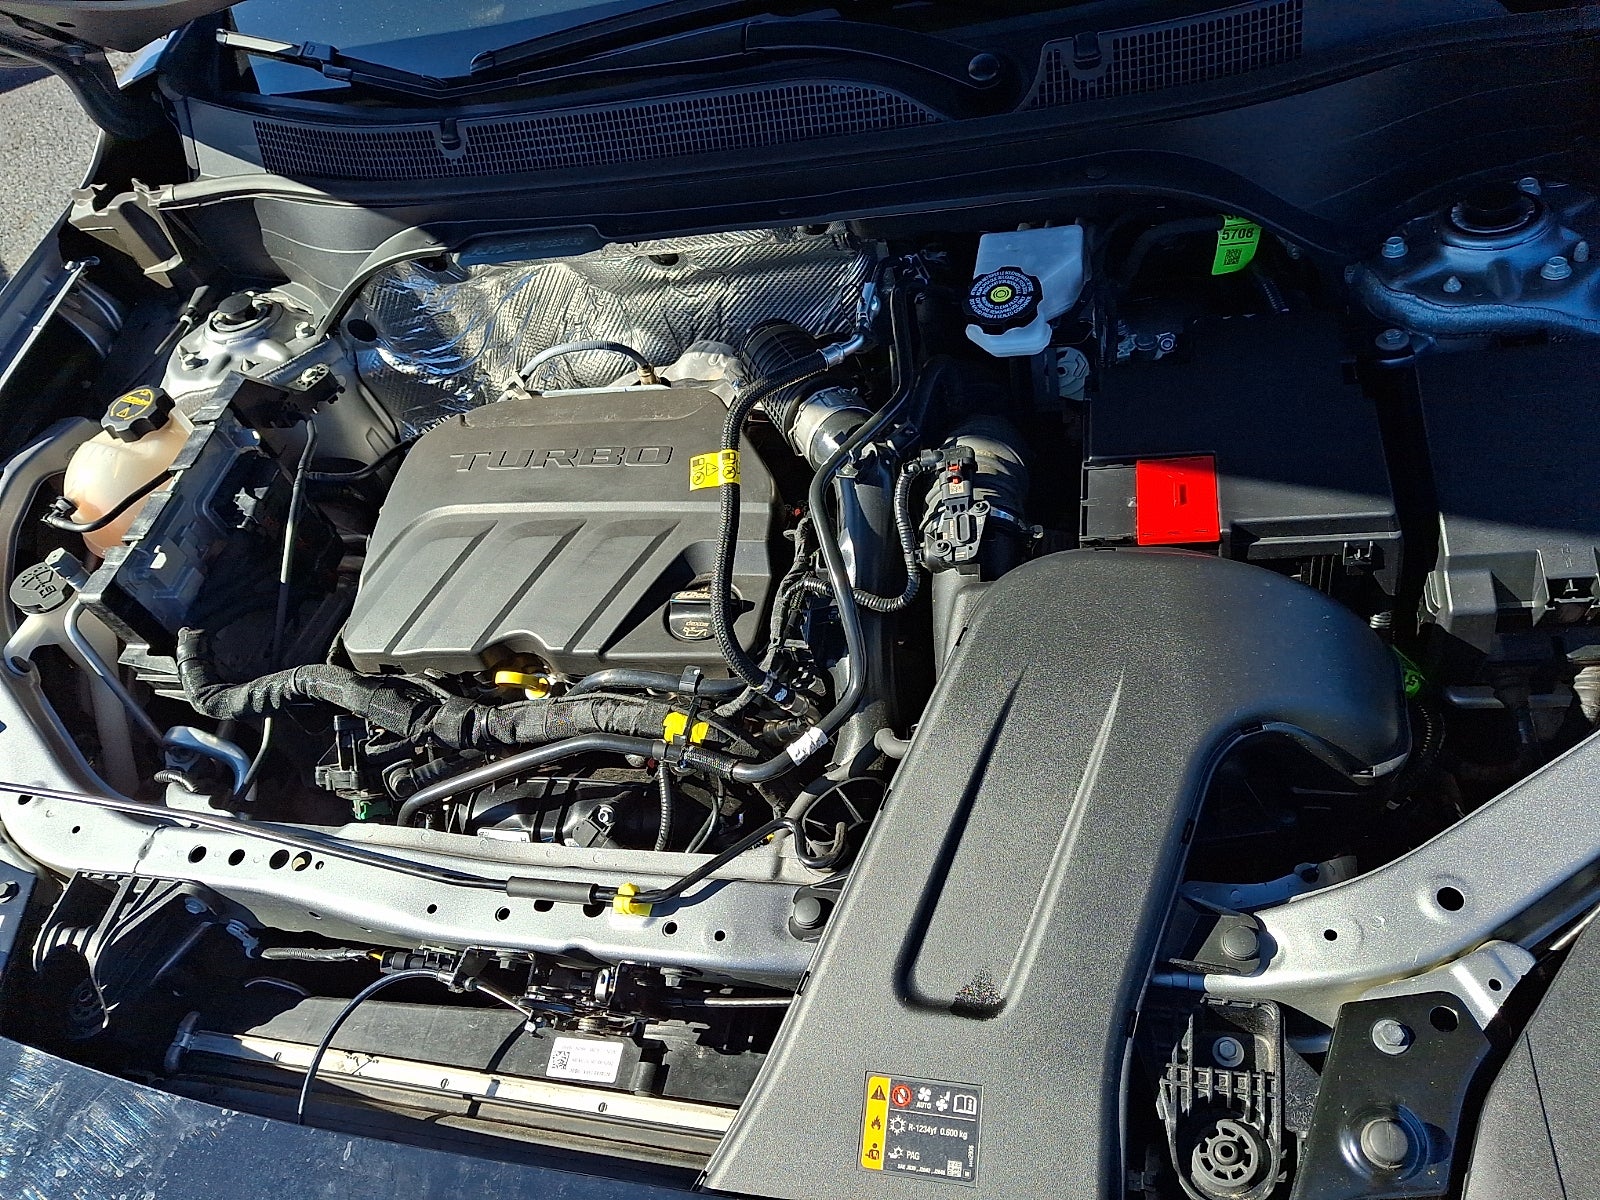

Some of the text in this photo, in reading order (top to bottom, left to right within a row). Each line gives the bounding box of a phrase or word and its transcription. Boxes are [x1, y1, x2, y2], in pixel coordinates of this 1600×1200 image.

[450, 446, 674, 472] TURBO
[916, 1101, 932, 1109] AUTO
[908, 1123, 937, 1136] R-1234yf
[959, 1130, 968, 1140] kg
[906, 1150, 920, 1161] PAG
